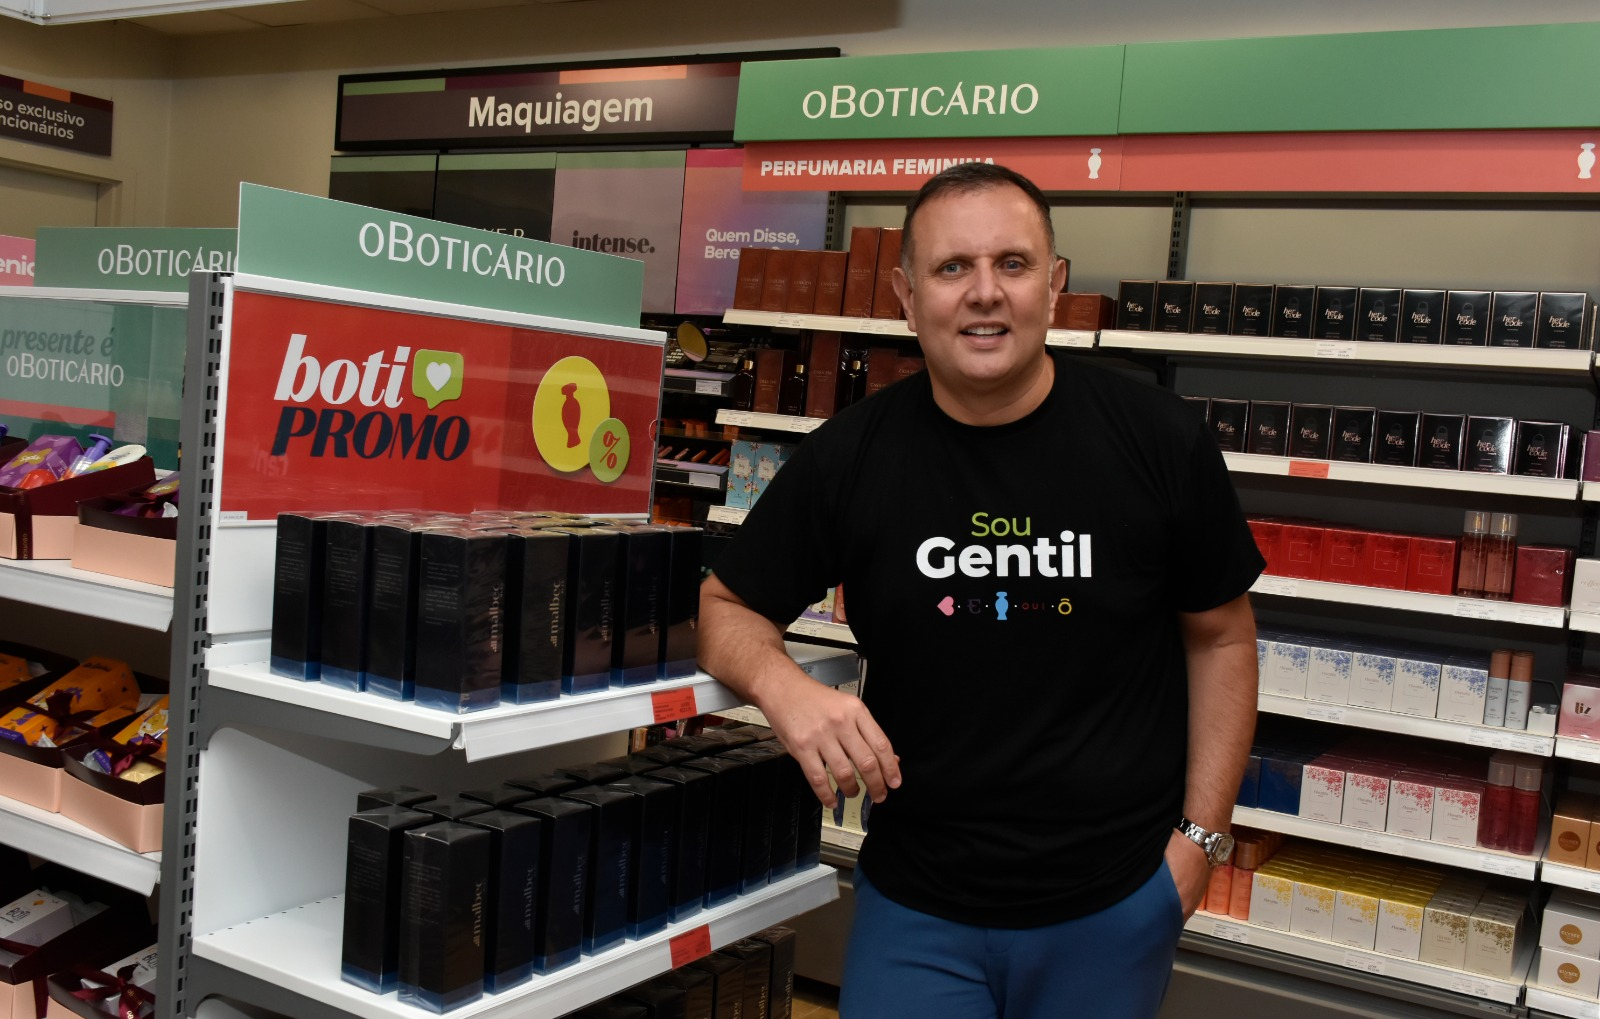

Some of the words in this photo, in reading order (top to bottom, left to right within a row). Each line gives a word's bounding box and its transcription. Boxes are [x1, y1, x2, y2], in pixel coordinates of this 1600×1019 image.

[18, 104, 85, 127] exclusivo
[468, 92, 654, 133] Maquiagem
[760, 159, 887, 177] PERFUMARIA
[572, 230, 656, 254] intense.
[705, 228, 750, 243] Quem
[753, 227, 800, 245] Disse,
[2, 327, 95, 356] presente
[101, 326, 116, 358] é
[273, 333, 412, 409] boti
[271, 406, 470, 461] PROMO
[971, 511, 1031, 537] Sou
[916, 530, 1092, 579] Gentil
[489, 584, 500, 637] malbec
[549, 580, 561, 637] malbec
